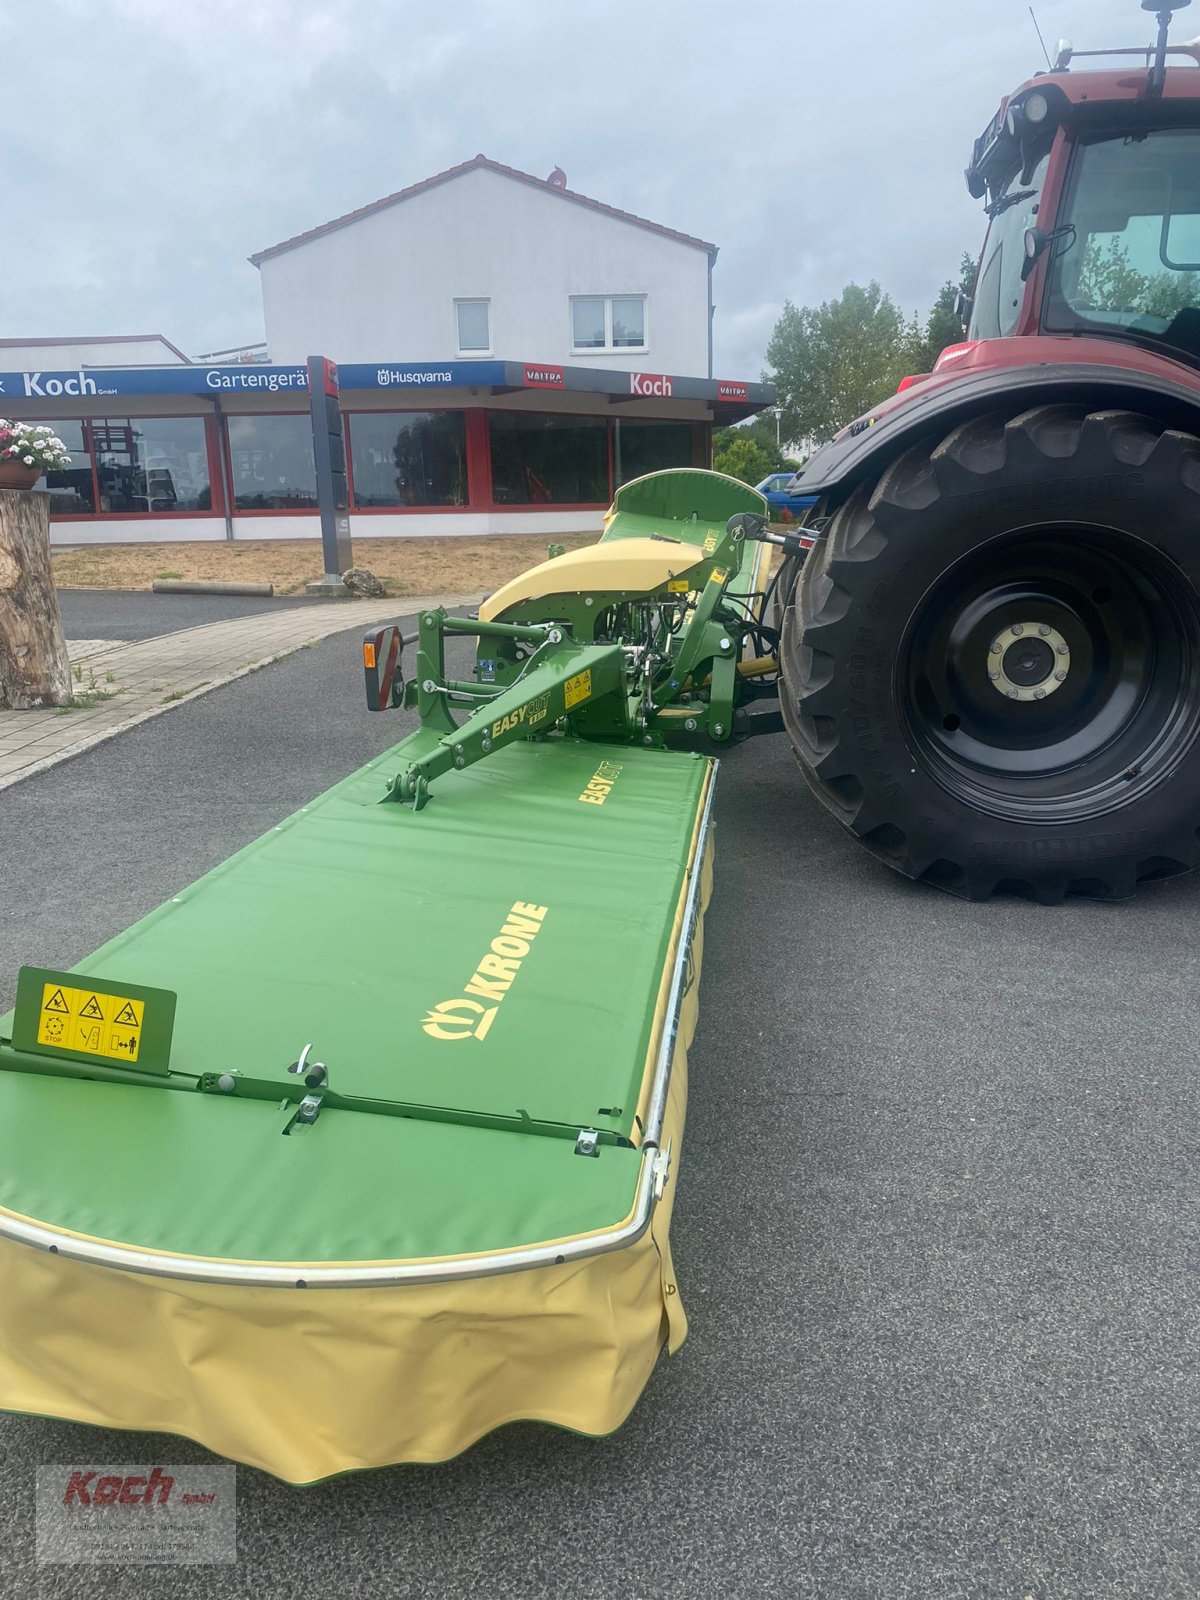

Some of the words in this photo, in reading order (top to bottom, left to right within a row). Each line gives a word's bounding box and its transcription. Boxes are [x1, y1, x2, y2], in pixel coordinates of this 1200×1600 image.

[23, 371, 97, 397] Koch
[391, 371, 452, 384] Husqvarna
[527, 370, 562, 383] VALTRA
[630, 373, 673, 396] Koch
[720, 387, 746, 398] VALTRA
[464, 901, 549, 1001] KRONE
